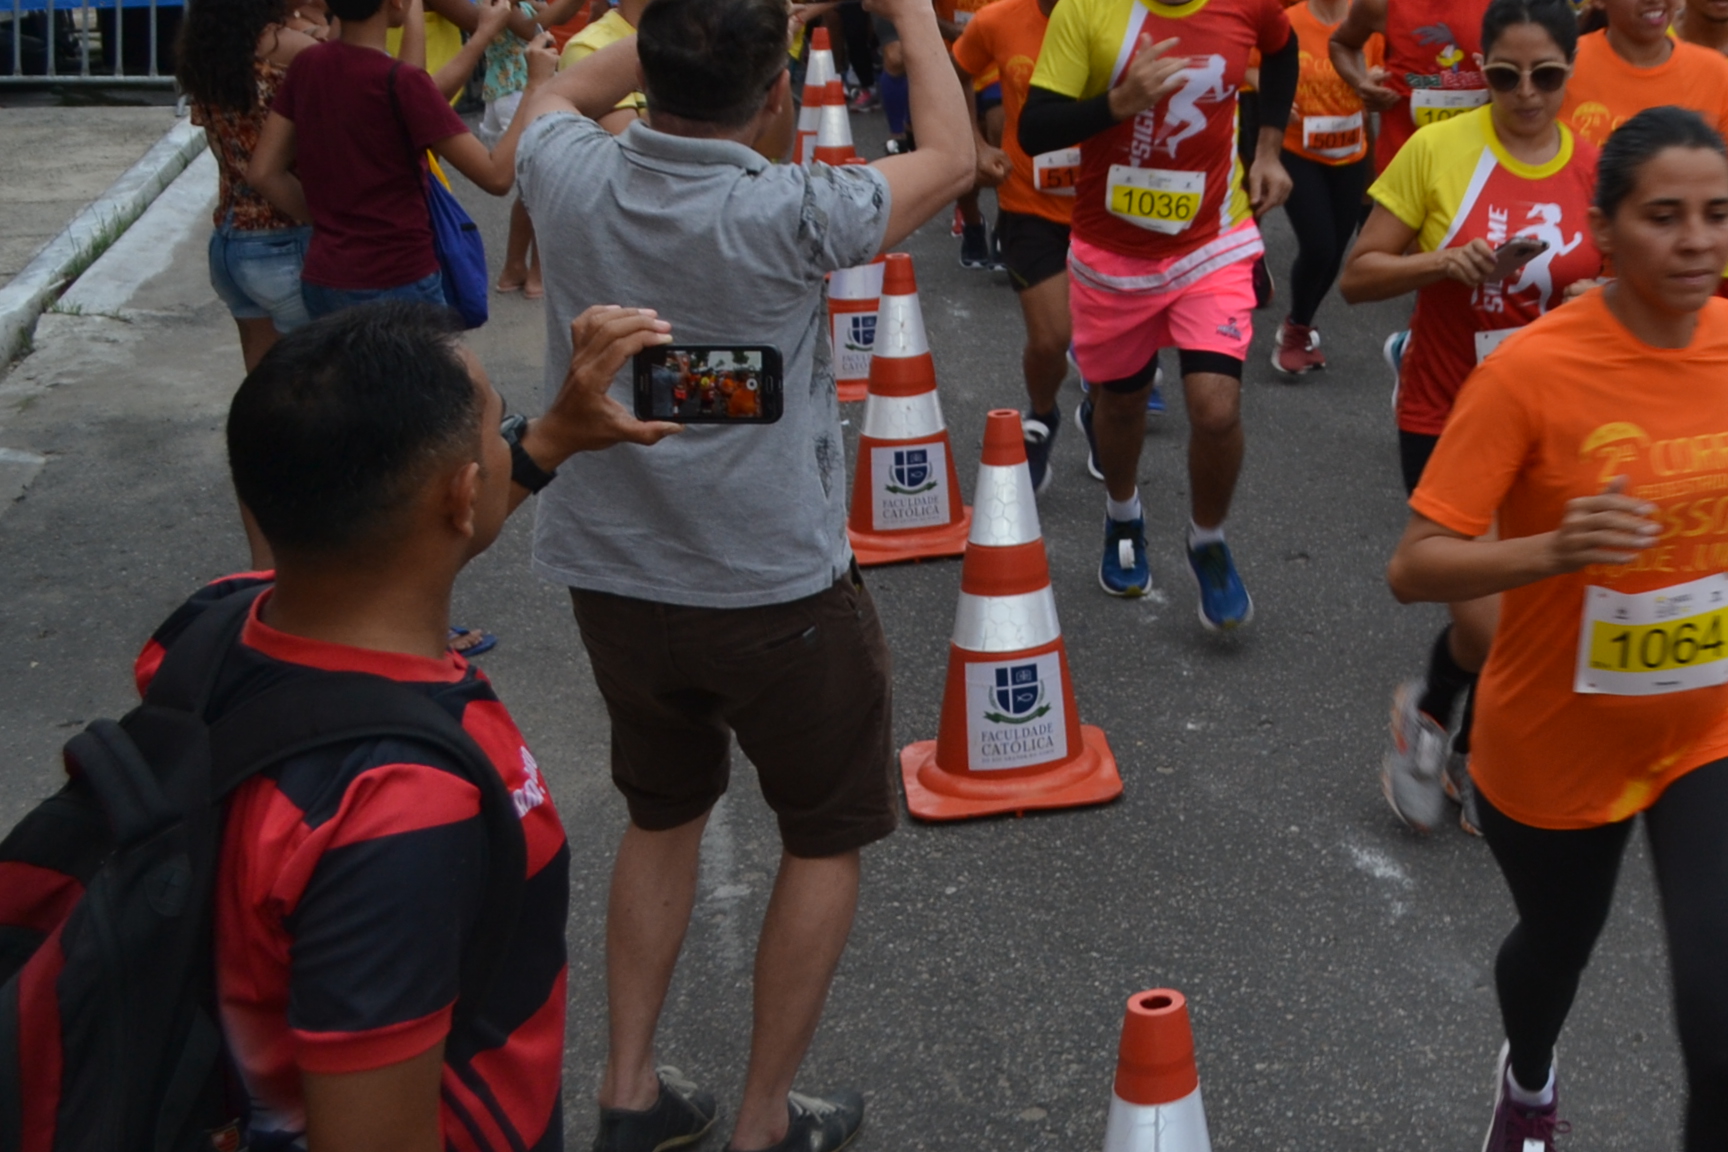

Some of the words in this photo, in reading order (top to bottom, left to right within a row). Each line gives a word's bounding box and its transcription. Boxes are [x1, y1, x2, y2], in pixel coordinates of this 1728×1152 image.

[1123, 189, 1192, 220] 1036
[882, 498, 938, 509] FACULDADE
[1611, 614, 1725, 669] 1064
[982, 723, 1053, 742] FACULDADE
